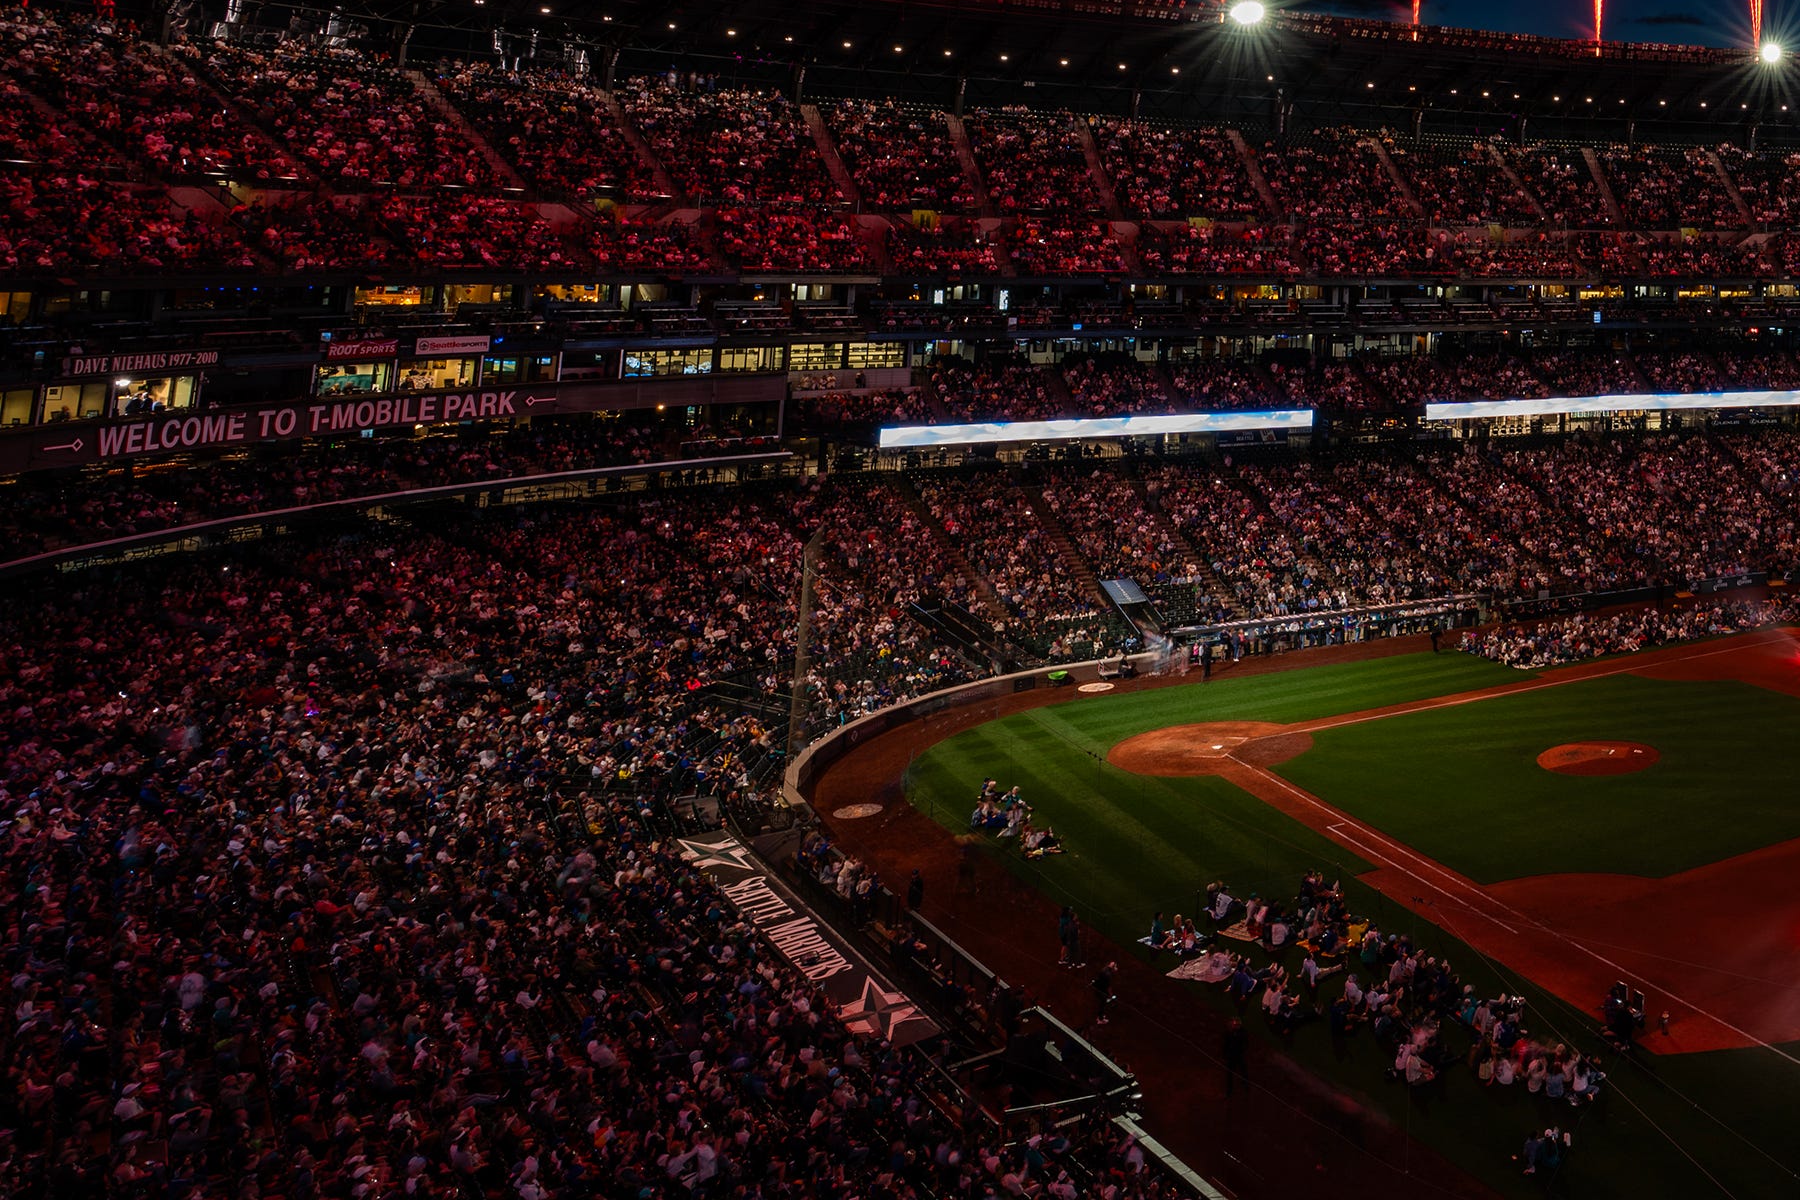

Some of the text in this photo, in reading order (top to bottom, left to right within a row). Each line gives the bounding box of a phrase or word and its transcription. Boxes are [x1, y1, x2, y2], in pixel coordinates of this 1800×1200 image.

[74, 351, 218, 375] DAVE NIEHAUS 1977-2010
[329, 344, 397, 356] ROOT SPORTS
[99, 391, 516, 457] WELCOME TO T-MOBILE PARK
[720, 876, 795, 924] SEATTLE
